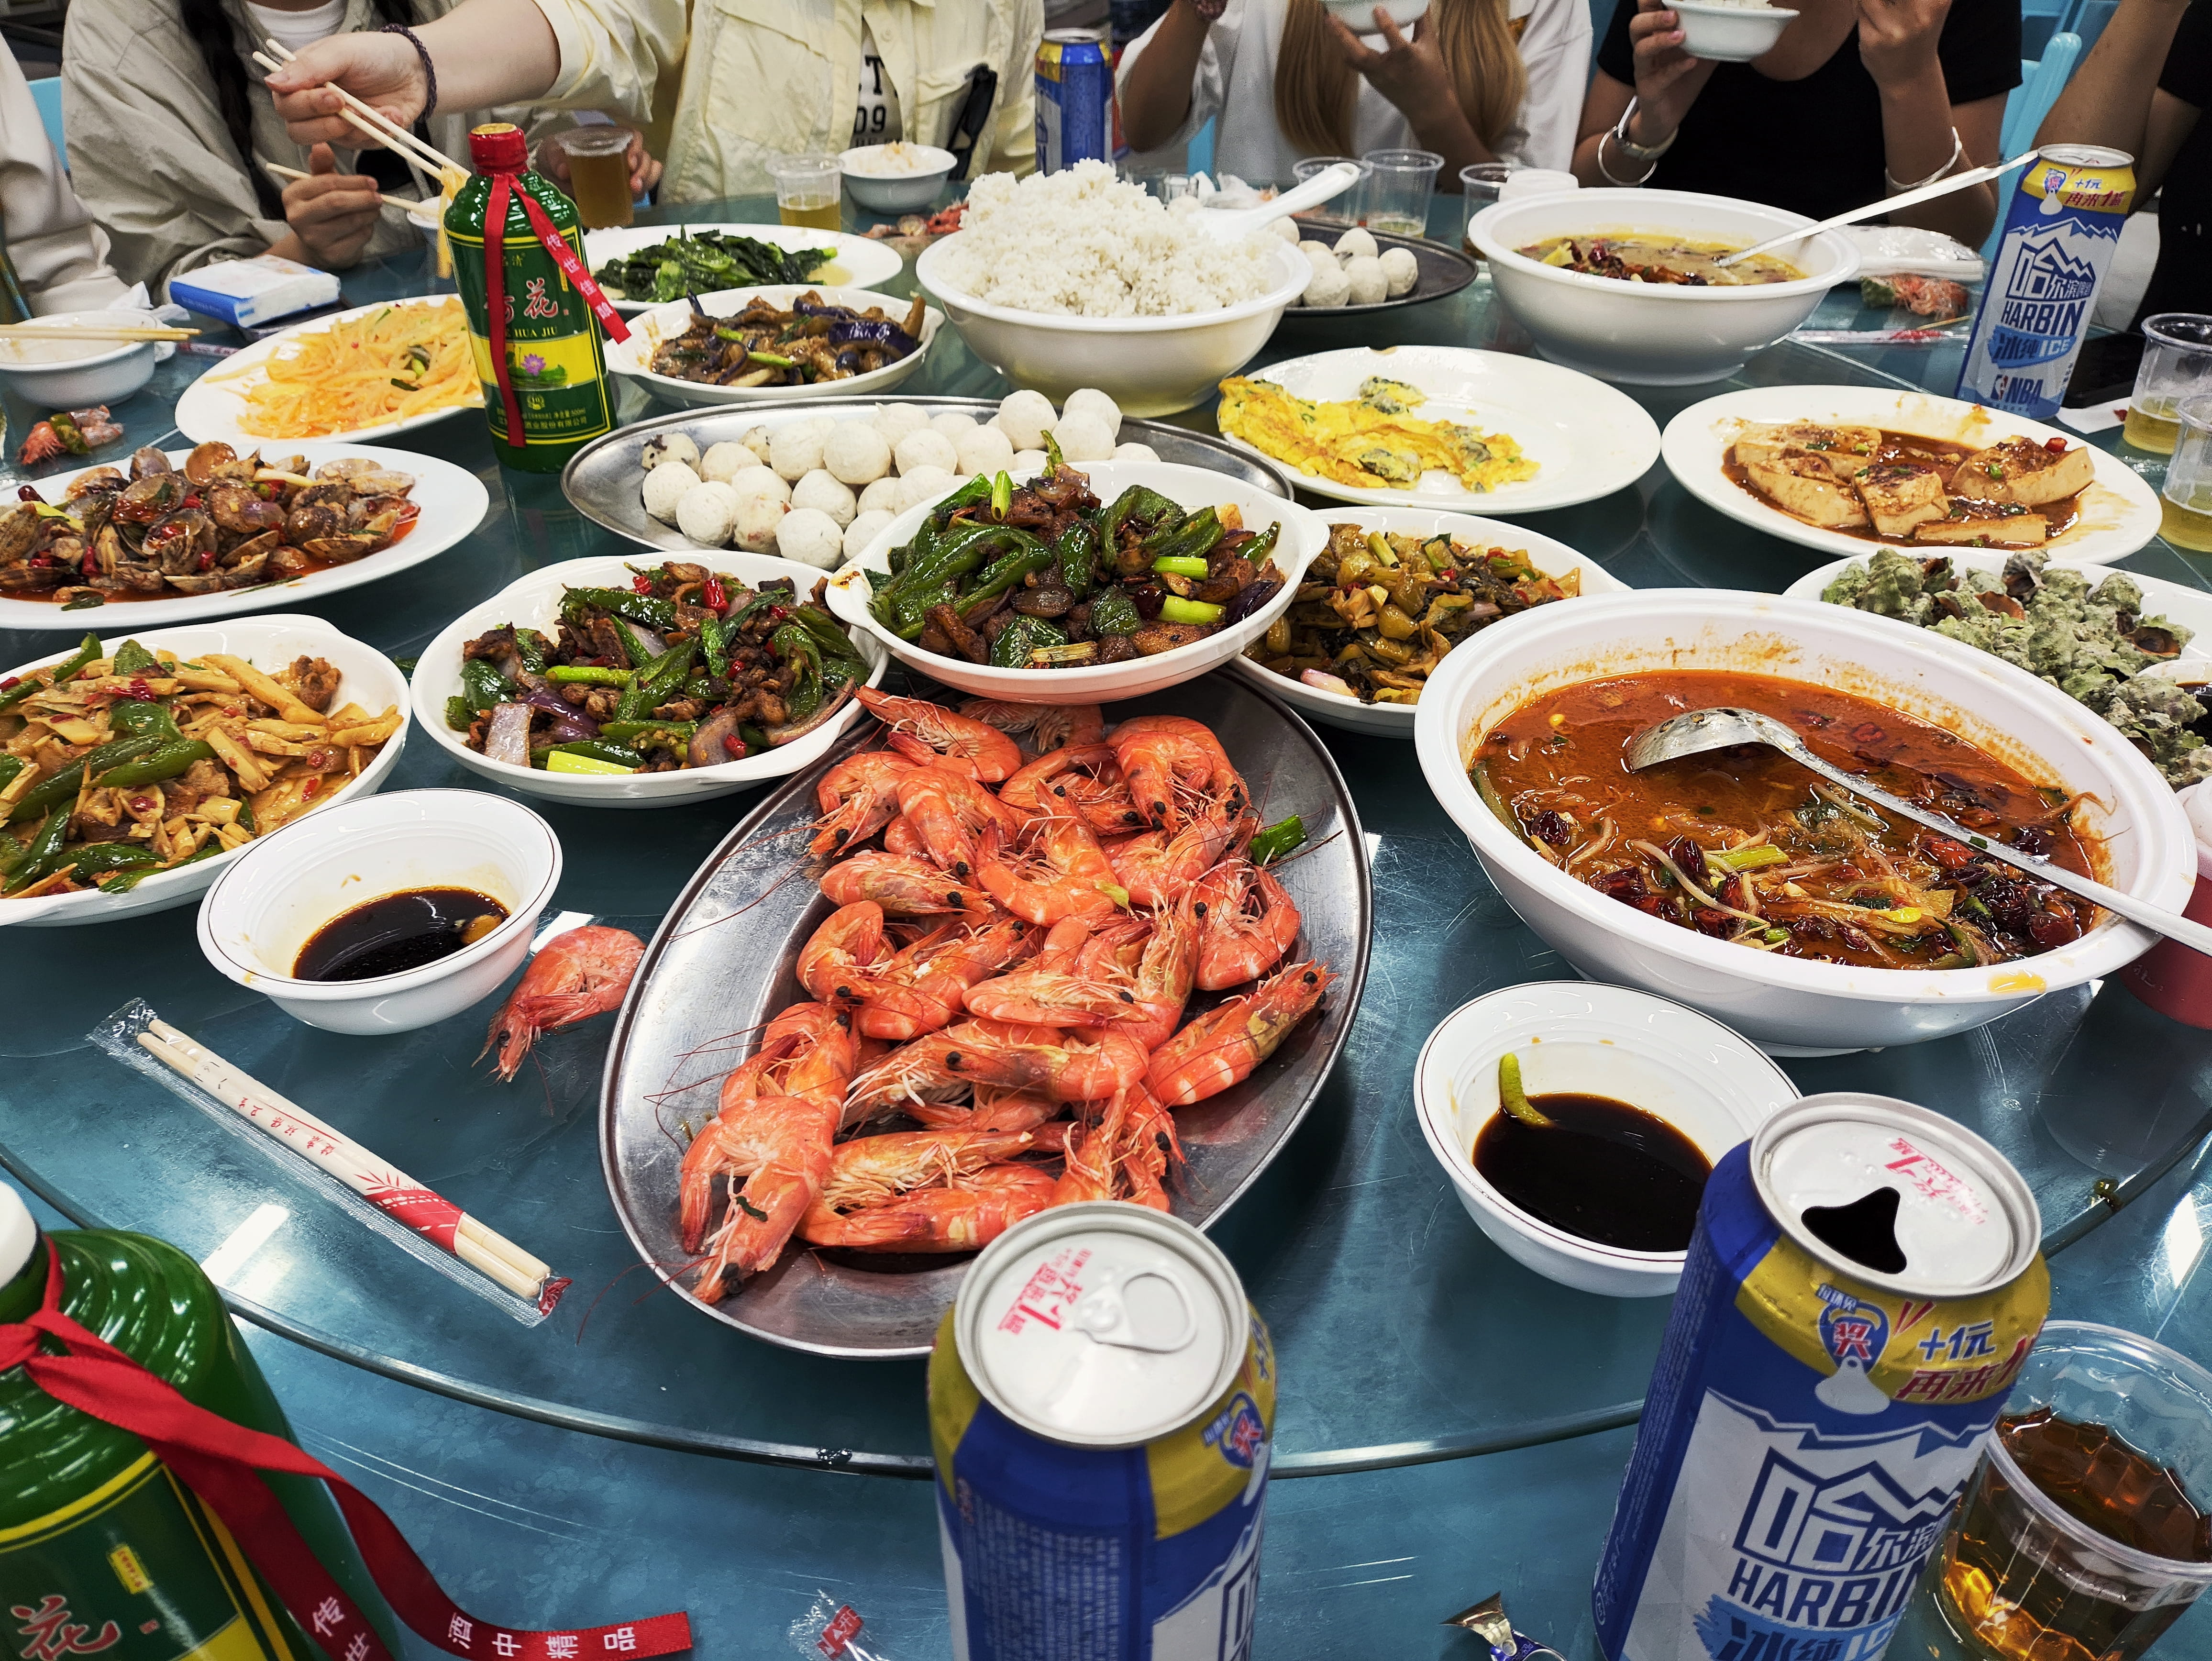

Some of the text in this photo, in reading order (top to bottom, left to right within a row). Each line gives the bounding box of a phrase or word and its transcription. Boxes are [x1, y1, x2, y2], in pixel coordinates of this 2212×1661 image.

[2075, 178, 2102, 189] +1元
[2001, 300, 2086, 337] HARBIN
[1993, 332, 2071, 360] 冰纯 ICE
[2005, 376, 2044, 405] NBA
[1833, 1321, 1872, 1361] 奖
[1918, 1319, 1997, 1362] +1元
[1894, 1328, 2042, 1400] 再来1
[448, 1611, 637, 1660] 酒中精品
